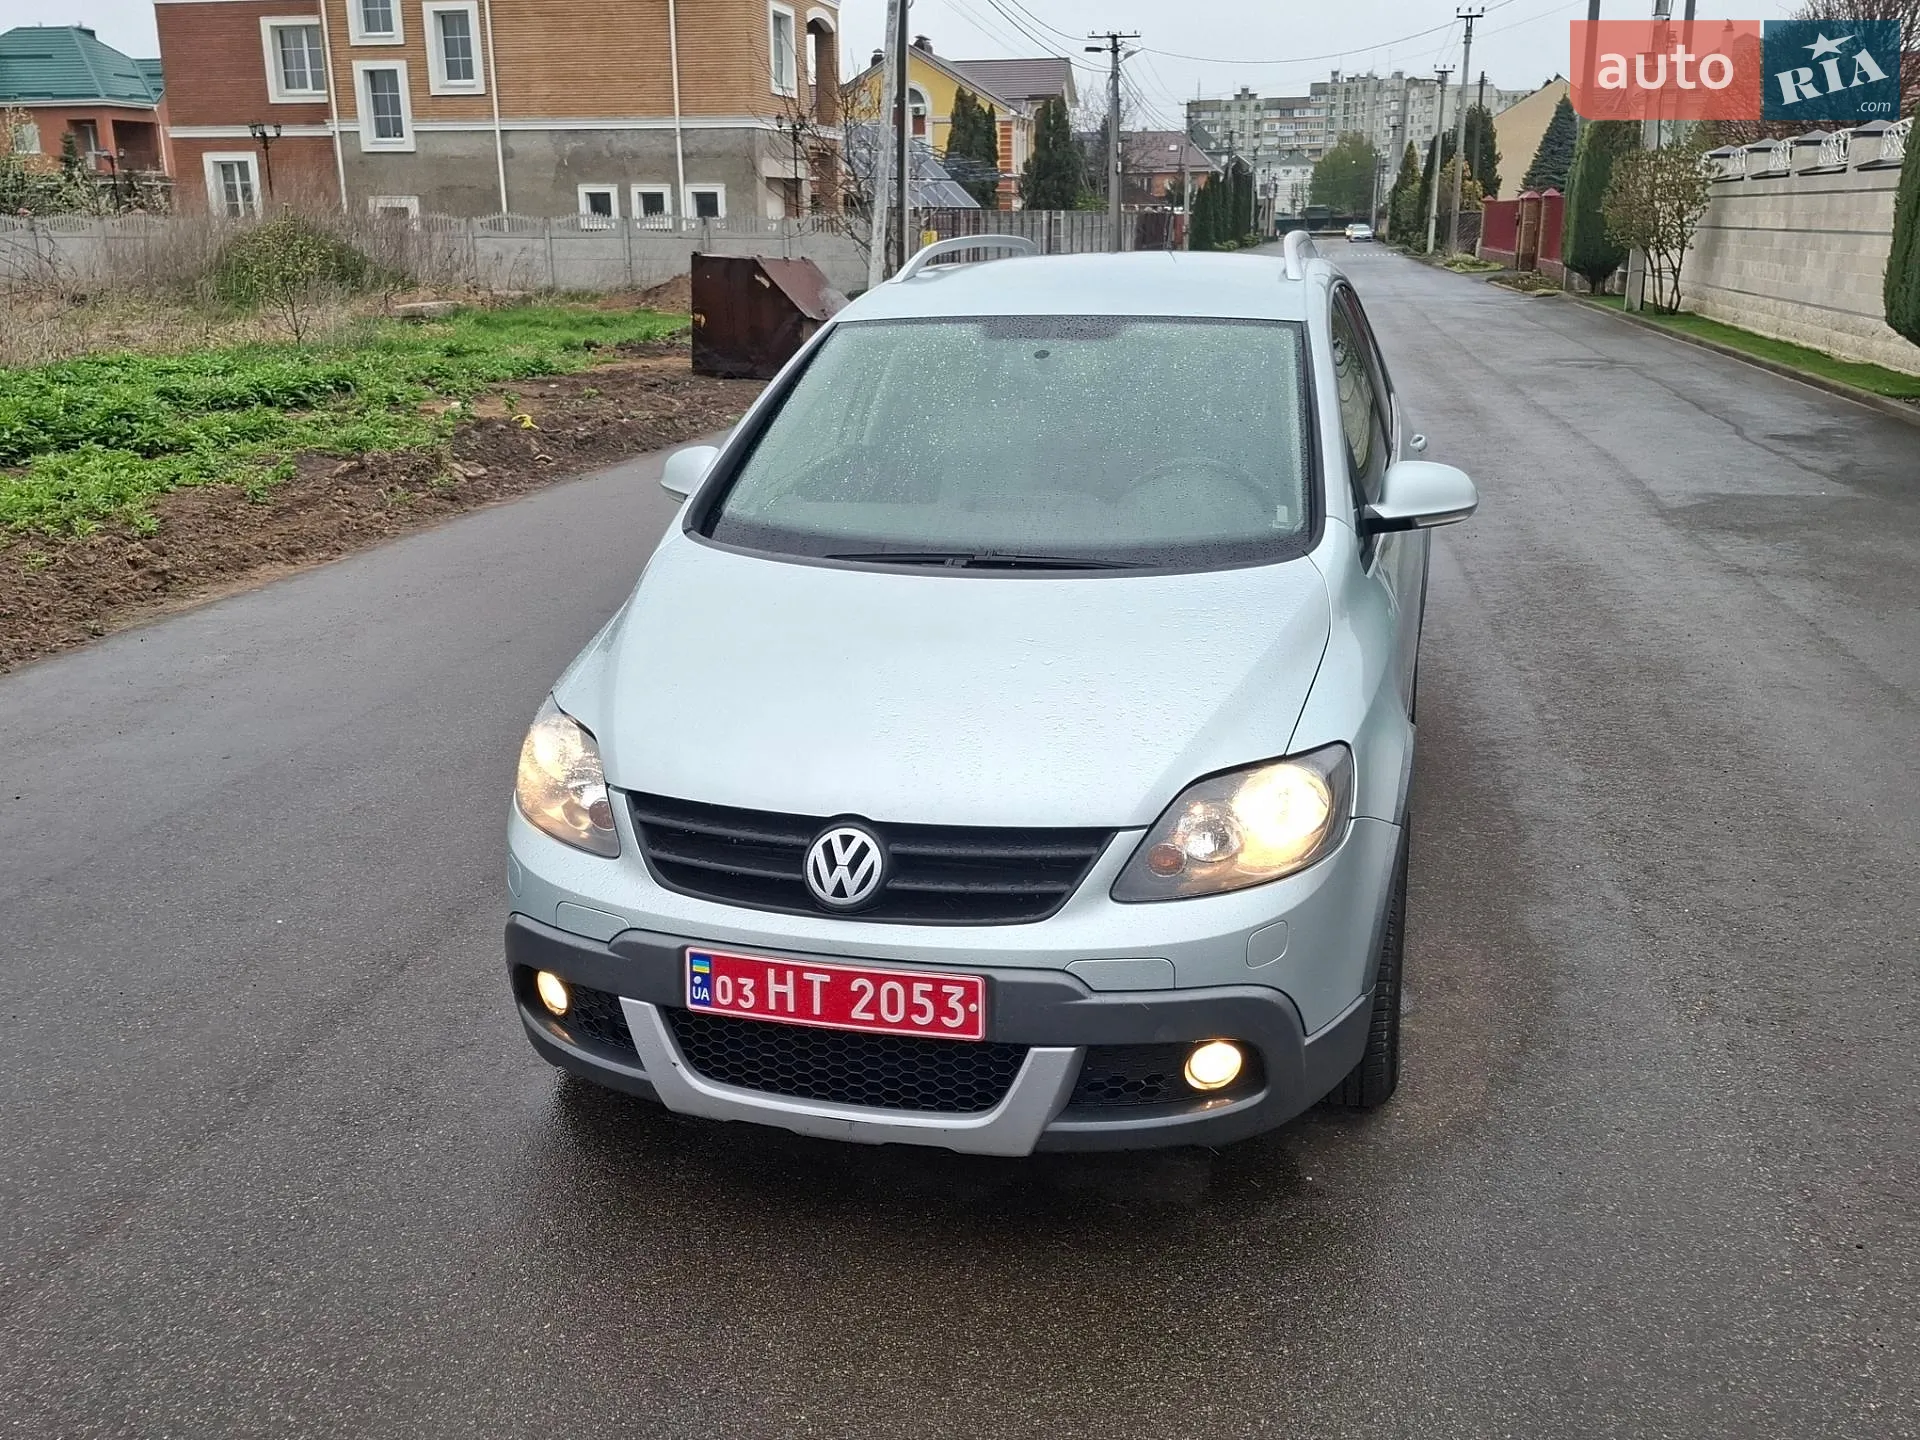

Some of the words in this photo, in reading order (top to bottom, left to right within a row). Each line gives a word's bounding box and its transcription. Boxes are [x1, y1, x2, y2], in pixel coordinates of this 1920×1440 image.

[807, 828, 882, 905] VW
[692, 986, 710, 1002] UA
[715, 975, 755, 1009] 03
[767, 968, 831, 1015] HT
[850, 978, 965, 1028] 2053
